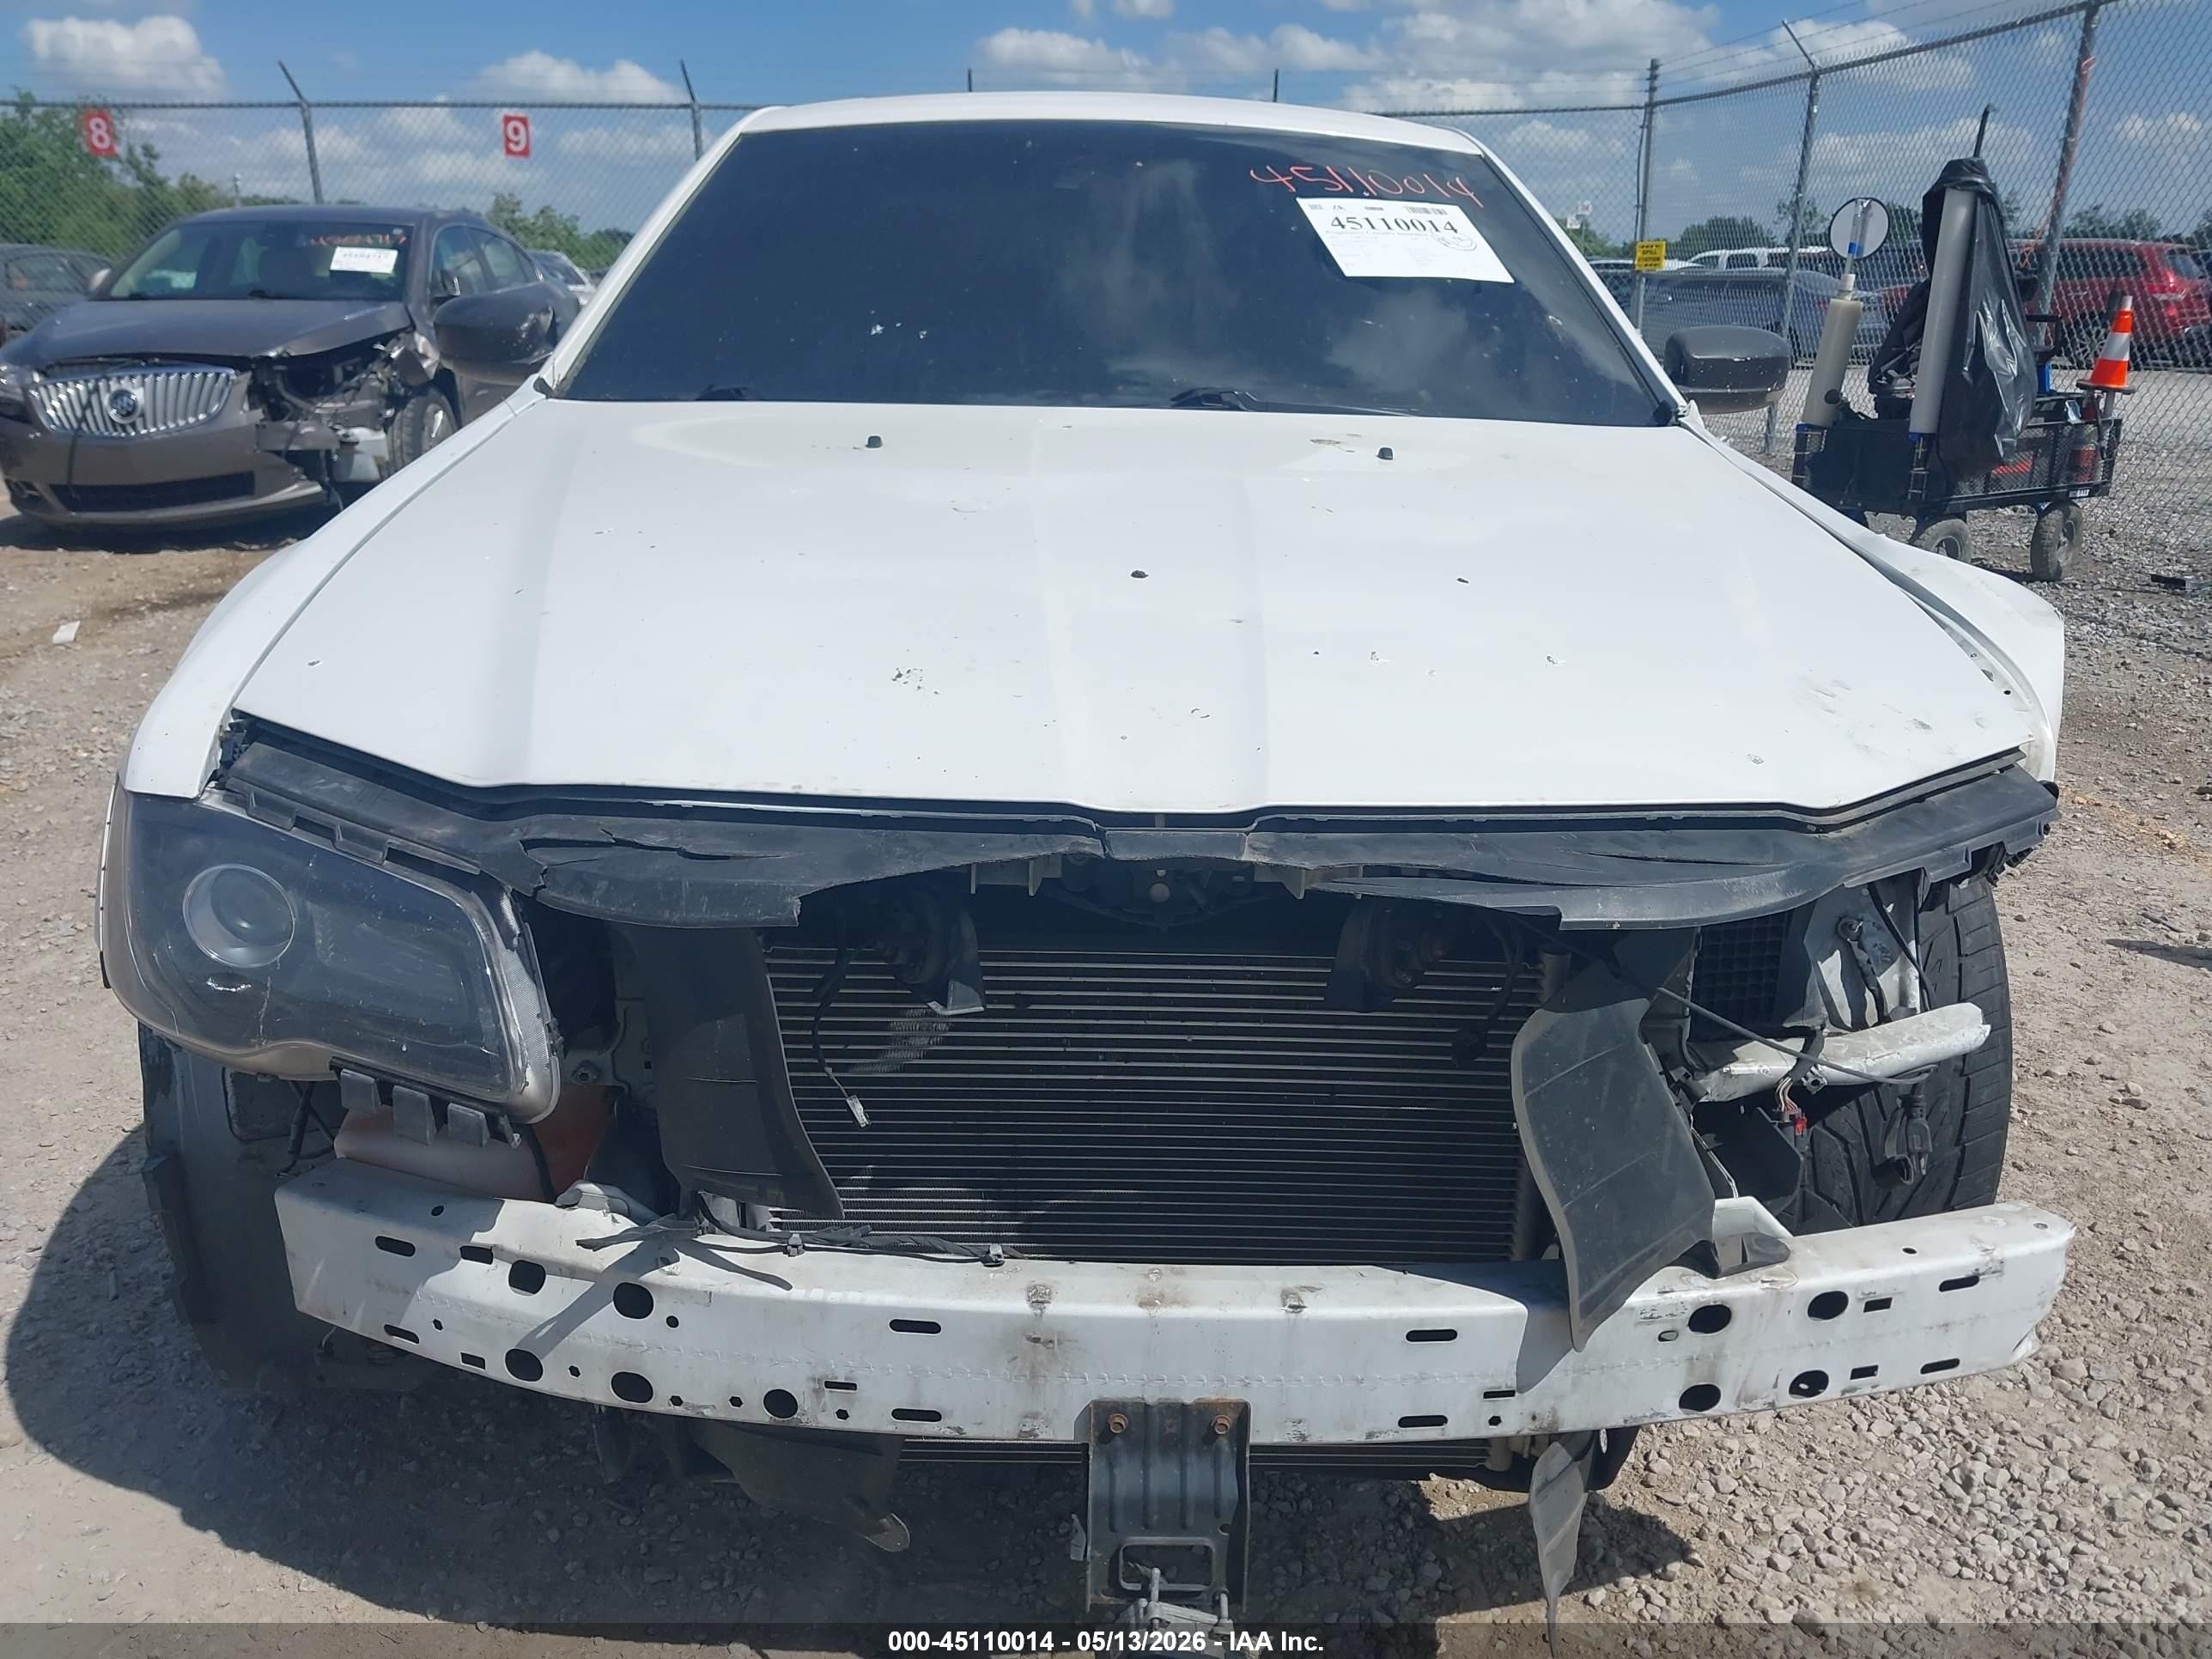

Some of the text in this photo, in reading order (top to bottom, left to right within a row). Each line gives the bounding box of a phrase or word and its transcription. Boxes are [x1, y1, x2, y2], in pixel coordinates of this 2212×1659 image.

[88, 117, 111, 150] 8
[507, 119, 527, 152] 9
[1249, 165, 1485, 209] 45110014
[1330, 216, 1459, 234] 45110014
